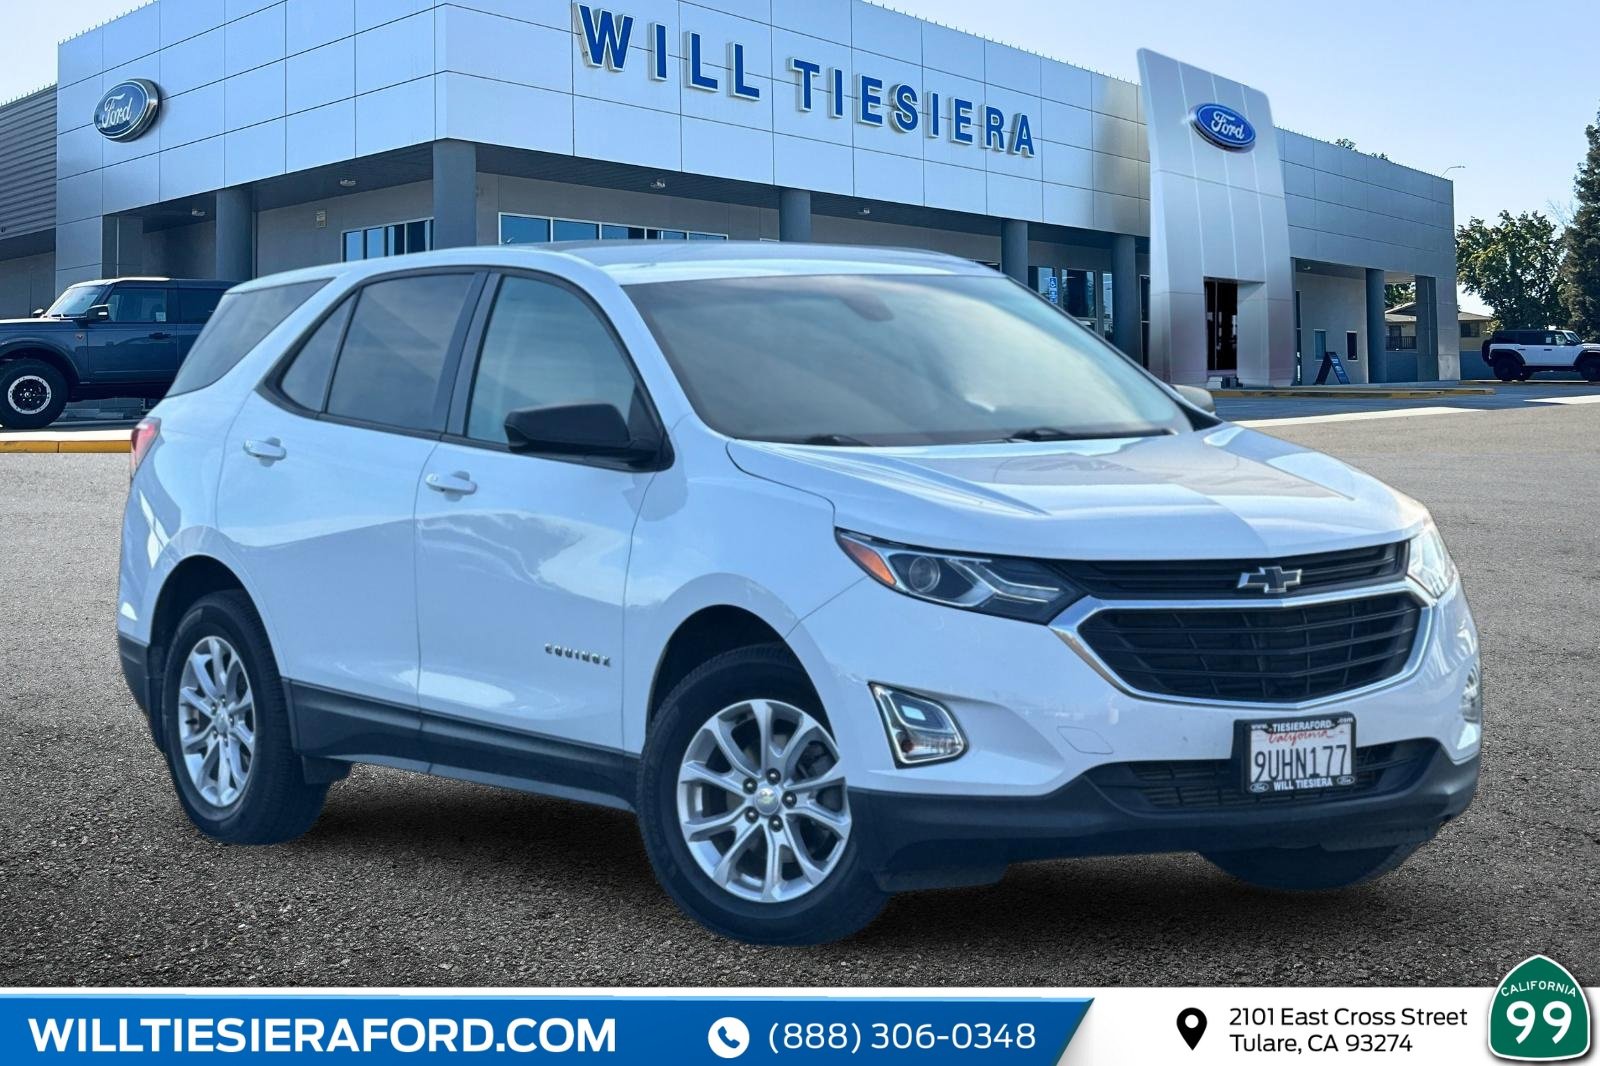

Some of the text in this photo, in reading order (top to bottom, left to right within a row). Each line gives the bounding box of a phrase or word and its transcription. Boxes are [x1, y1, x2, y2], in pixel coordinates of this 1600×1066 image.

[574, 2, 1036, 158] WILL TIESIERA
[100, 93, 133, 128] Ford
[1211, 110, 1245, 140] Ford
[544, 642, 611, 667] EQUINOX
[1254, 744, 1347, 783] 9UHN177
[1273, 779, 1295, 792] WILL
[1296, 776, 1334, 790] TIESIERA
